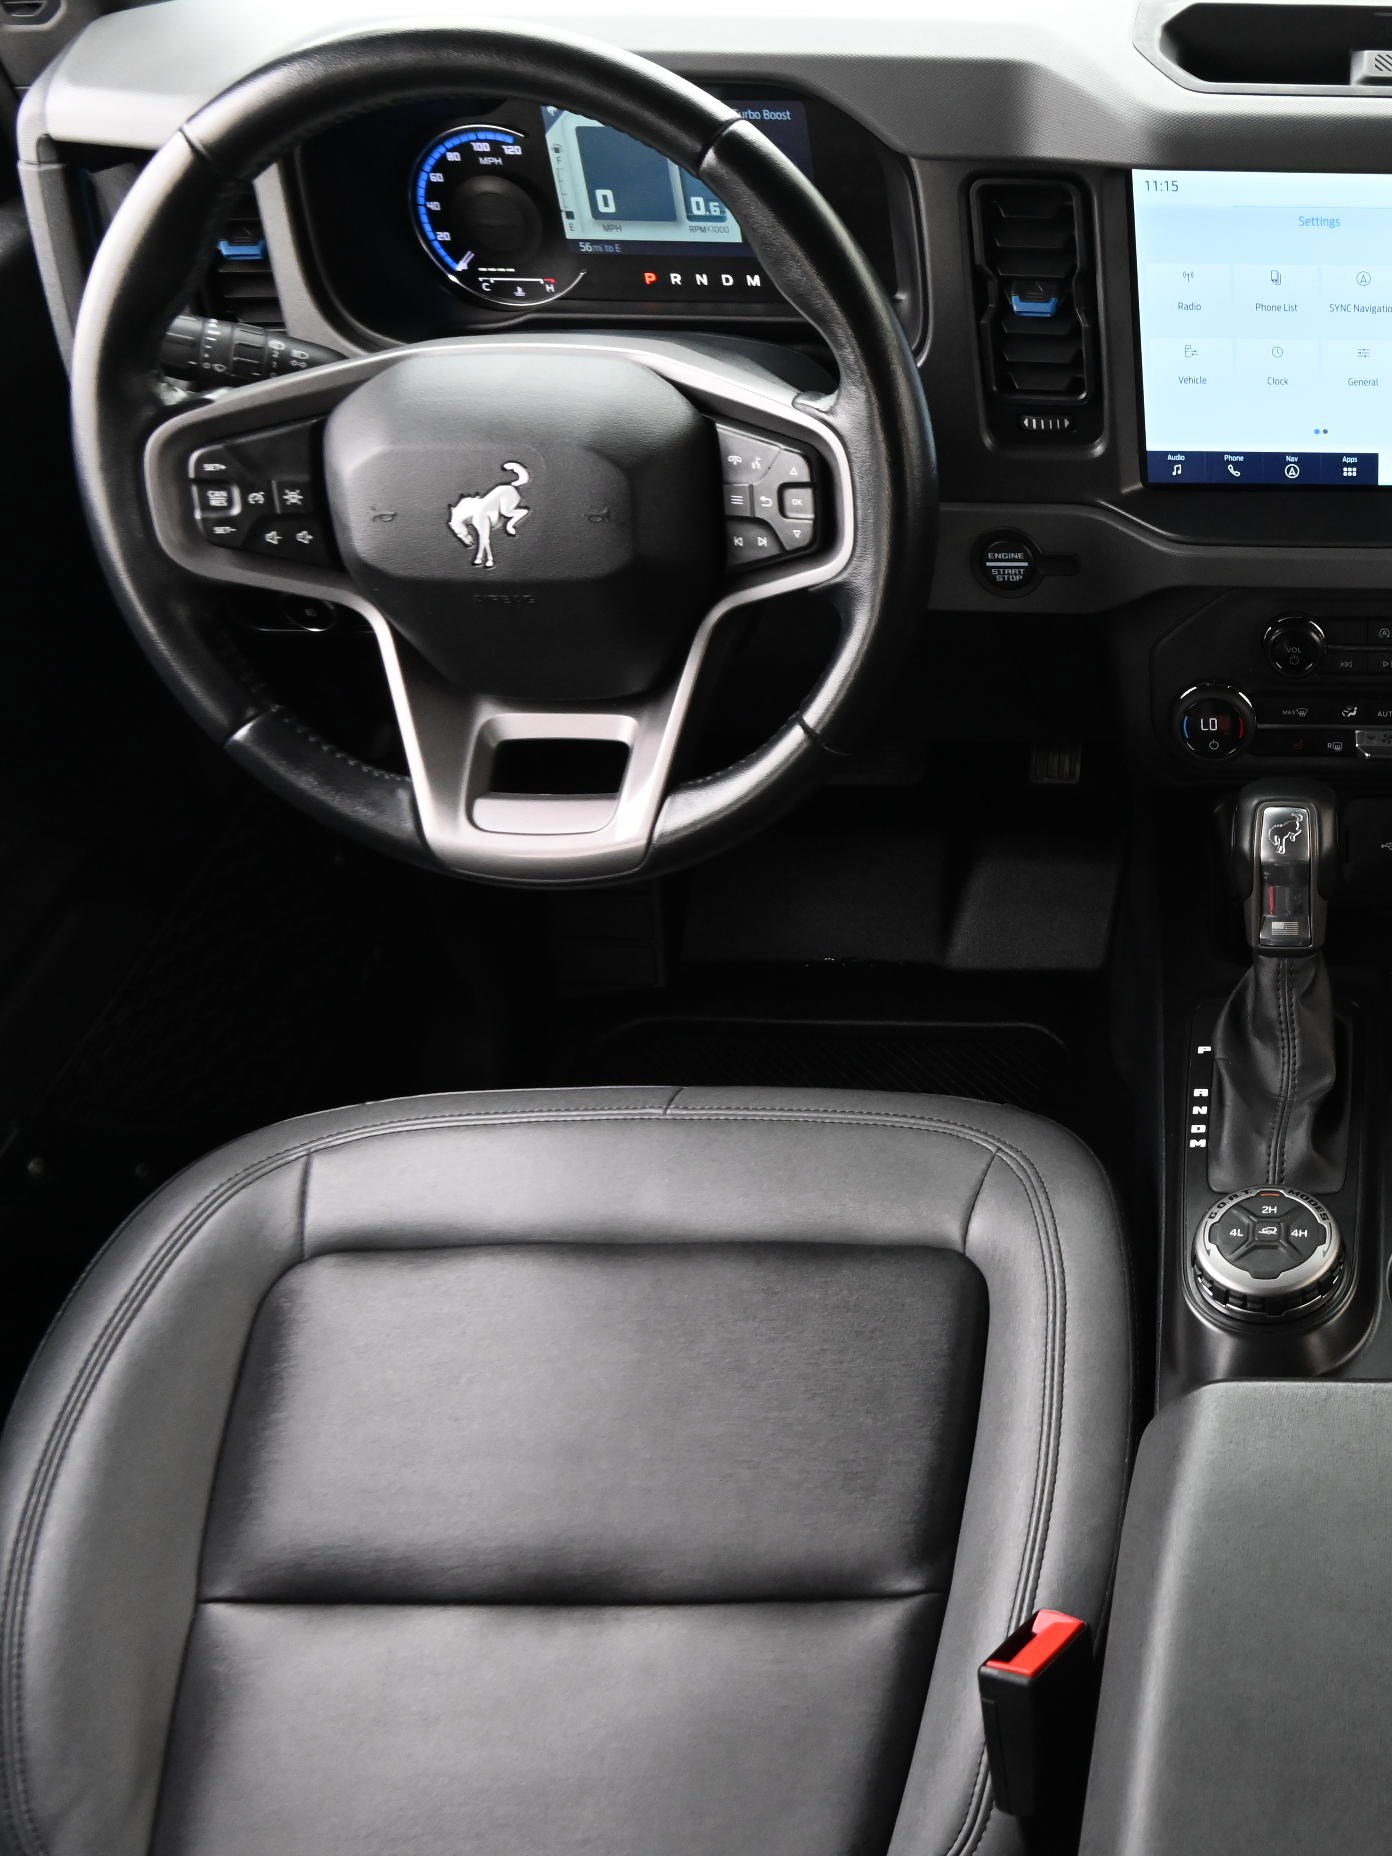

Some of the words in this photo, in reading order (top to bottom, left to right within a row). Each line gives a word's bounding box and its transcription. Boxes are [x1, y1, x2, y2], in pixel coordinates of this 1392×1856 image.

[763, 109, 791, 120] Boost
[471, 142, 491, 152] 100
[502, 145, 522, 155] 120
[446, 152, 461, 161] 80
[479, 157, 503, 165] MPH
[429, 172, 444, 182] 60
[1145, 180, 1179, 192] 11:15
[595, 189, 616, 213] 0
[426, 202, 441, 211] 40
[690, 197, 721, 216] 0.6
[1298, 216, 1341, 228] Settings
[602, 224, 623, 232] MPH
[436, 232, 451, 241] 20
[644, 273, 657, 284] P
[671, 273, 682, 285] R
[696, 274, 708, 285] N
[722, 275, 734, 286] D
[747, 275, 761, 287] M
[482, 283, 491, 291] C
[546, 284, 555, 293] H
[1178, 302, 1202, 311] Radio
[1255, 303, 1282, 312] Phone
[1283, 303, 1298, 312] List
[1329, 304, 1352, 313] SYNC
[1178, 376, 1207, 385] Vehicle
[1267, 377, 1289, 386] Clock
[1348, 378, 1379, 387] General
[1224, 454, 1244, 462] Phone
[1286, 455, 1299, 463] Nav
[1342, 456, 1358, 465] Apps
[988, 552, 1024, 560] ENGINE
[1200, 717, 1218, 731] LO
[1198, 1046, 1211, 1054] P
[1192, 1106, 1208, 1114] N
[1190, 1125, 1206, 1133] D
[1189, 1139, 1207, 1148] M
[1261, 1205, 1277, 1214] 2H
[1287, 1189, 1330, 1221] MODES
[1229, 1228, 1244, 1237] 4L
[1290, 1229, 1308, 1238] 4H
